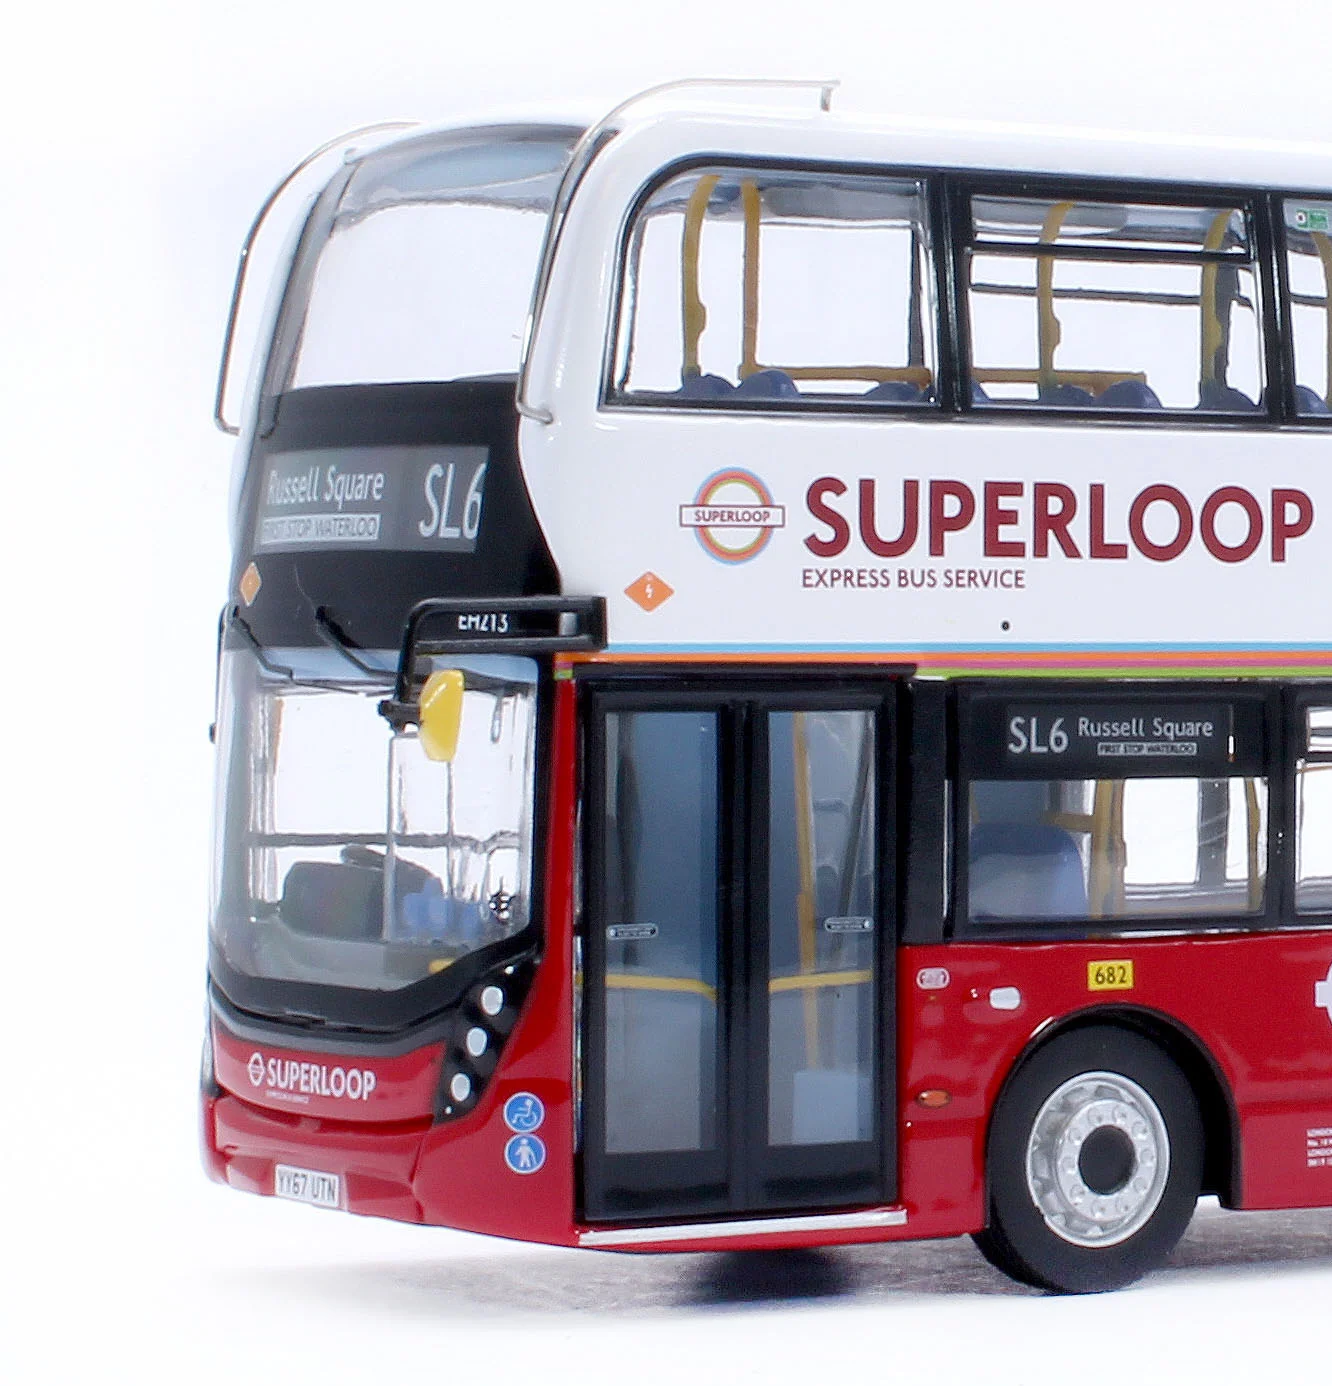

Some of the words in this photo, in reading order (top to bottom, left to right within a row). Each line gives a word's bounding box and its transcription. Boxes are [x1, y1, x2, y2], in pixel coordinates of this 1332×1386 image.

[267, 466, 319, 505] Russell
[324, 464, 385, 511] Square
[419, 462, 487, 539] SL6
[313, 517, 377, 538] WATERLOO
[695, 510, 769, 522] SUPERLOOP
[804, 476, 1314, 563] SUPERLOOP
[802, 568, 890, 588] EXPRESS
[898, 569, 937, 589] BUS
[944, 569, 1025, 590] SERVICE
[1008, 716, 1068, 753] SL6
[1077, 717, 1145, 737] Russell
[1152, 717, 1213, 740] Square
[1095, 965, 1127, 985] 682
[267, 1058, 376, 1100] SUPERLOOP
